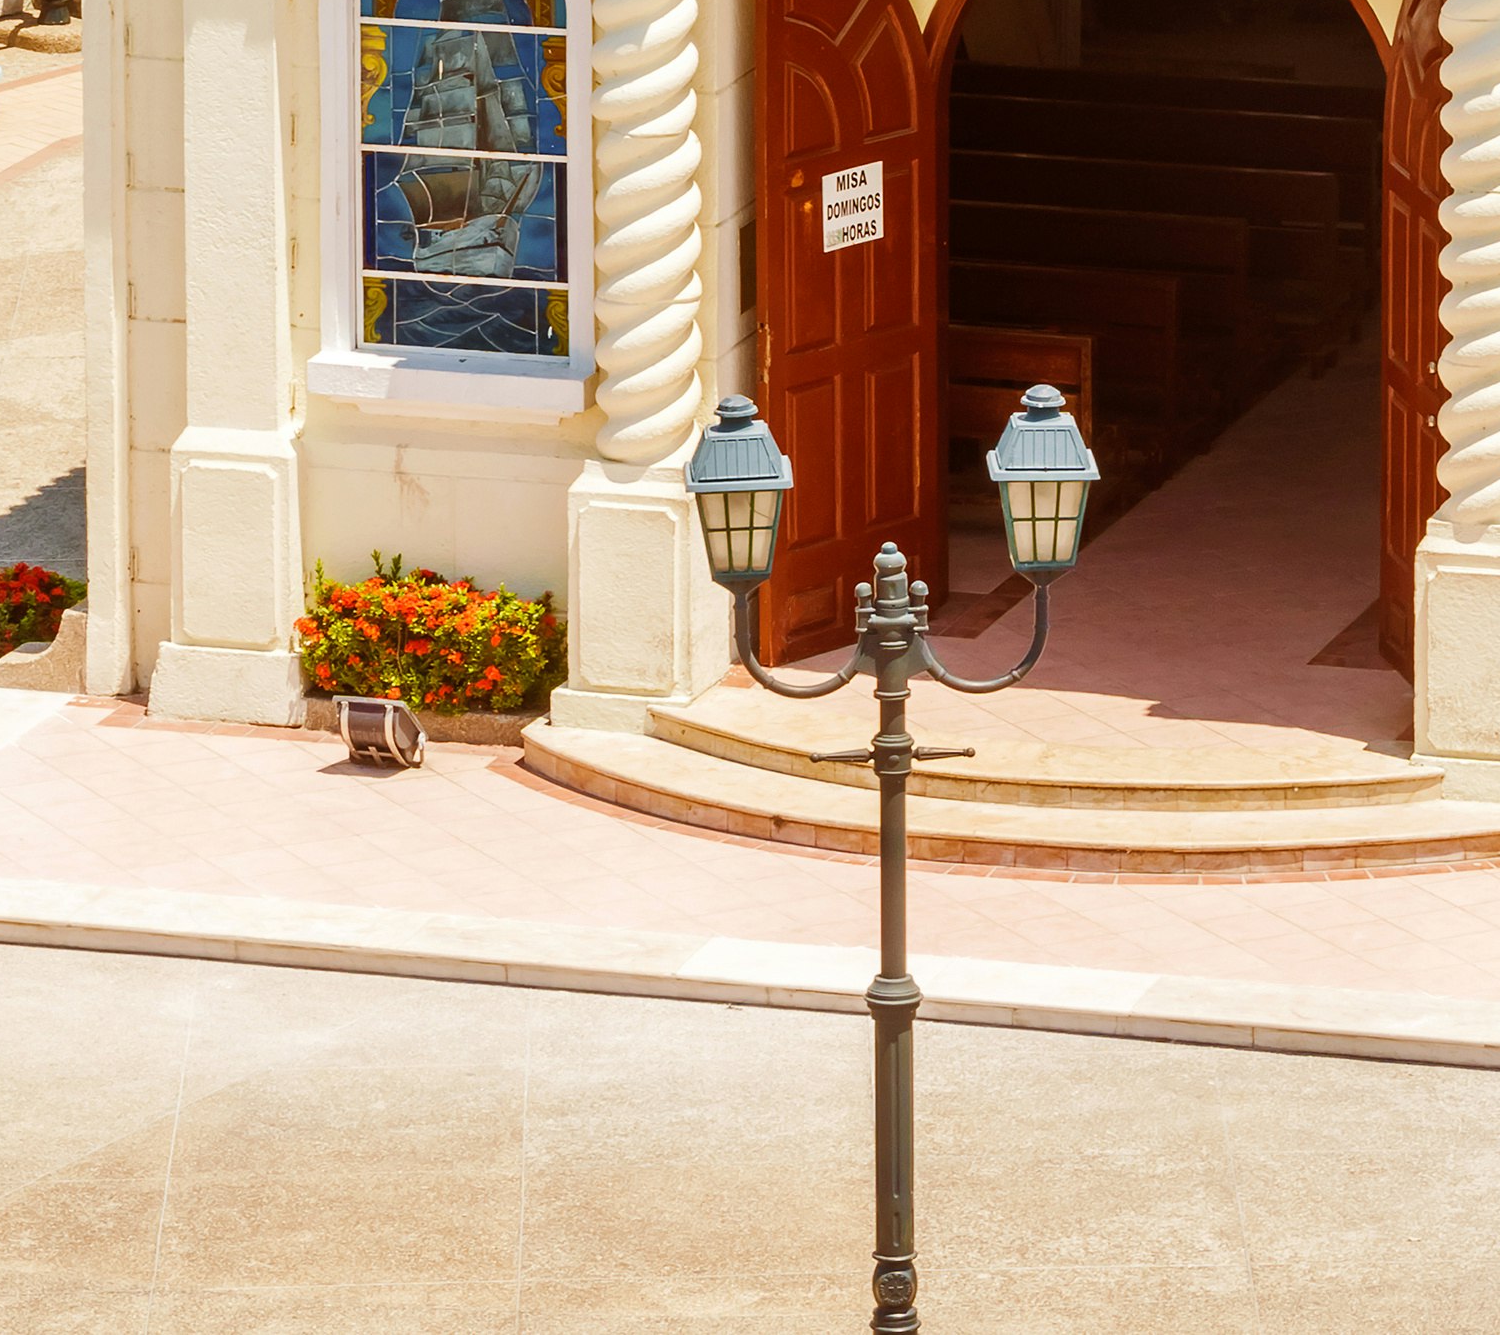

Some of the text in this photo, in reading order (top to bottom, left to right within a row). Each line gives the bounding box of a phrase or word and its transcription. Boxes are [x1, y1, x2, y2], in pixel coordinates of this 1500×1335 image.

[836, 170, 867, 192] MISA
[827, 192, 881, 220] DOMINGOS
[842, 219, 877, 243] HORAS
